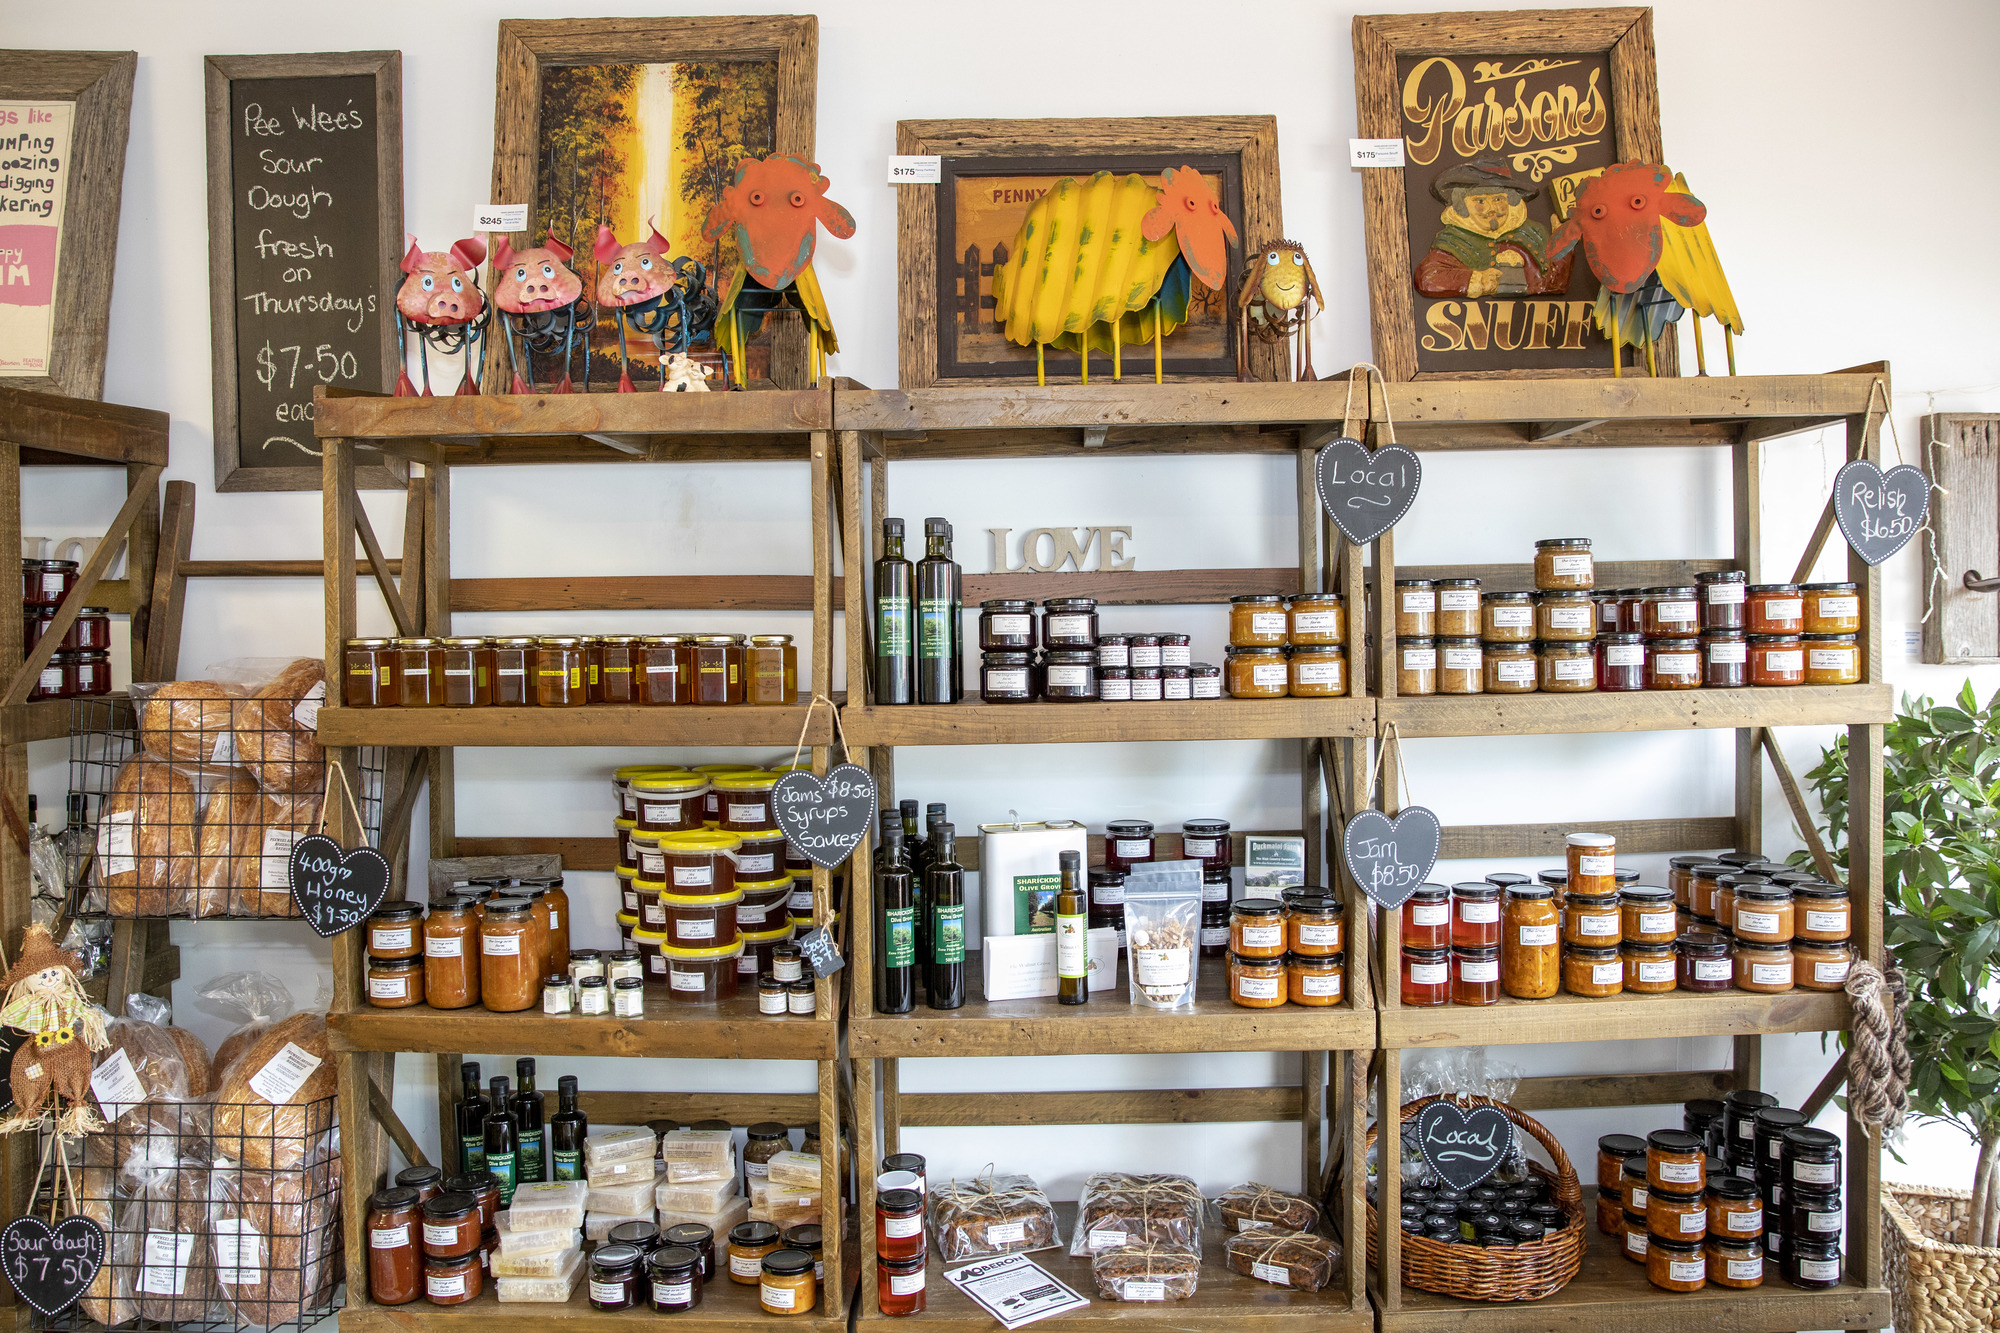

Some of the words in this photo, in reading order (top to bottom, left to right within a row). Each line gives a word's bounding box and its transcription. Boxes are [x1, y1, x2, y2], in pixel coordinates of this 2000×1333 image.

[28, 108, 52, 124] like
[244, 103, 285, 136] Pee
[1402, 57, 1607, 165] Parsons
[260, 149, 322, 174] Sour
[1356, 151, 1376, 159] $175
[893, 168, 916, 176] $175
[248, 184, 333, 219] Dough
[993, 188, 1047, 204] PENNY
[480, 216, 502, 224] $245
[254, 228, 334, 260] fresh
[283, 266, 311, 282] on
[1421, 301, 1595, 351] SNUFF
[275, 402, 314, 422] eac
[1332, 460, 1405, 489] Local
[1852, 481, 1906, 517] Relish
[988, 526, 1136, 573] LOVE
[782, 786, 823, 803] Jams
[787, 805, 848, 829] Syrups
[799, 831, 859, 848] Sauces
[1355, 837, 1403, 865] Jam
[299, 852, 353, 886] 400gm
[306, 881, 367, 912] Honey
[1427, 1116, 1498, 1151] Local
[9, 1230, 50, 1251] Sour
[52, 1230, 97, 1258] dough
